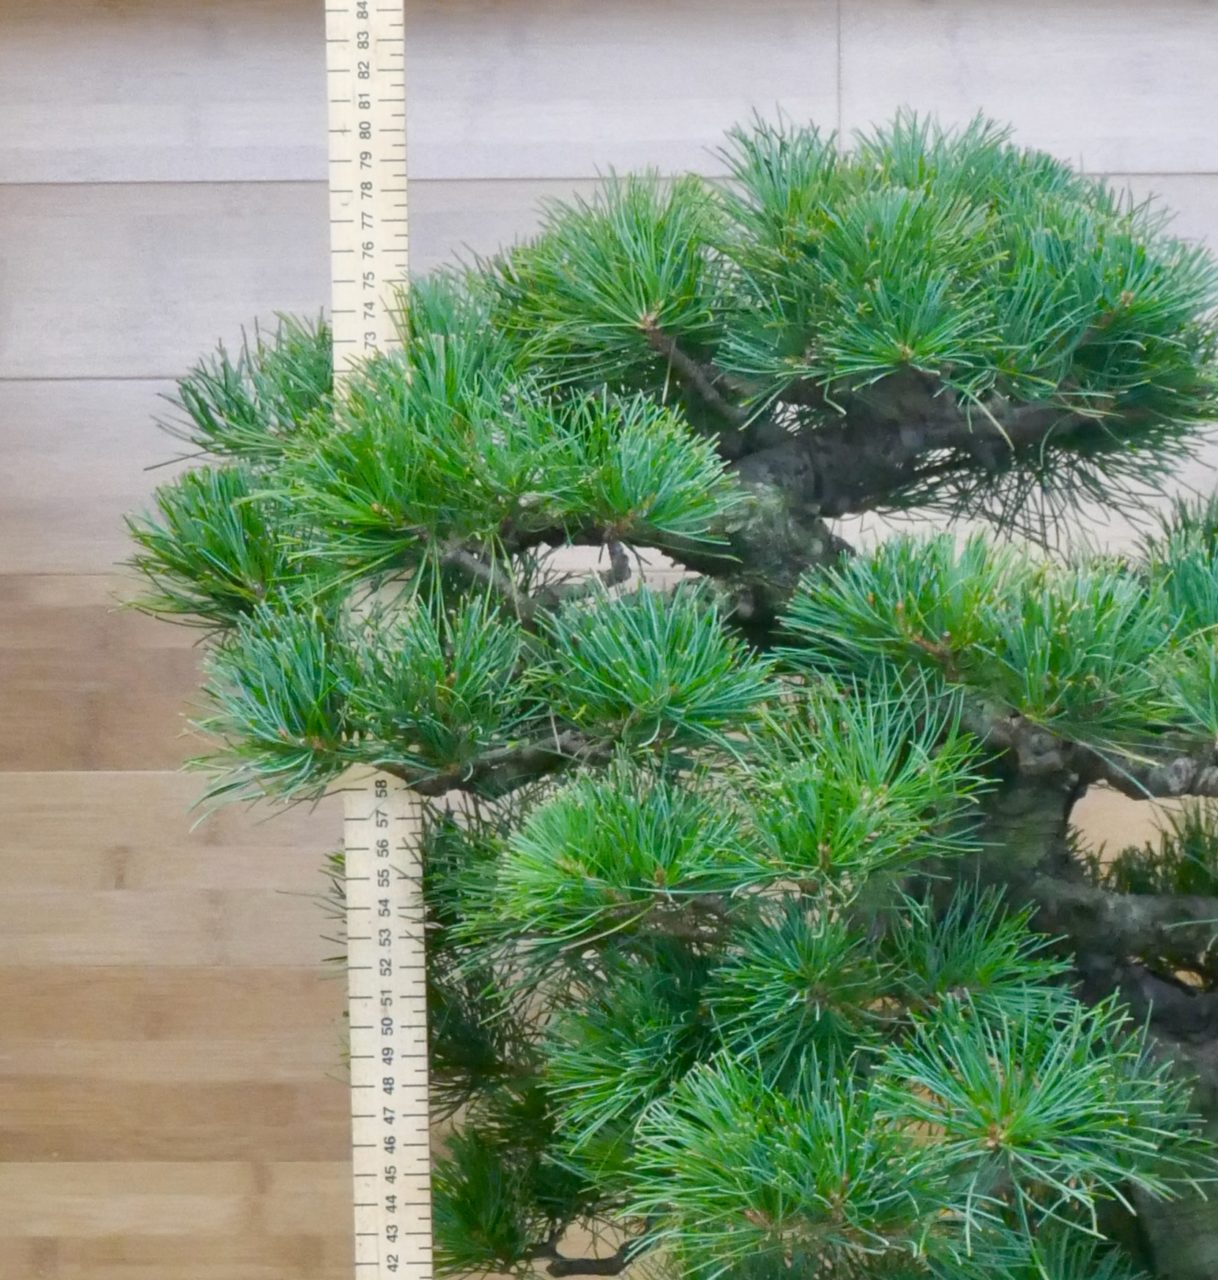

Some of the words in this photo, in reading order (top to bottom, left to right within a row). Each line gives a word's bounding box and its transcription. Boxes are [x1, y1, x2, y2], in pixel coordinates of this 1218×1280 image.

[355, 0, 369, 20] 84
[356, 30, 370, 50] 83
[357, 60, 371, 80] 82
[357, 93, 371, 110] 81
[358, 120, 372, 140] 80
[359, 150, 373, 170] 79
[359, 180, 373, 200] 78
[360, 210, 374, 231] 77
[361, 240, 375, 260] 76
[362, 271, 376, 290] 75
[363, 301, 376, 320] 74
[363, 331, 377, 351] 73
[374, 779, 388, 799] 58
[375, 809, 389, 828] 57
[376, 838, 390, 858] 56
[376, 868, 391, 888] 55
[377, 898, 391, 918] 54
[378, 927, 392, 948] 53
[378, 958, 393, 977] 52
[379, 989, 393, 1008] 51
[380, 1016, 394, 1036] 50
[381, 1046, 395, 1066] 49
[382, 1076, 395, 1096] 48
[382, 1106, 396, 1126] 47
[383, 1135, 397, 1155] 46
[384, 1165, 397, 1185] 45
[384, 1194, 398, 1214] 44
[385, 1224, 399, 1244] 43
[386, 1253, 399, 1273] 42
